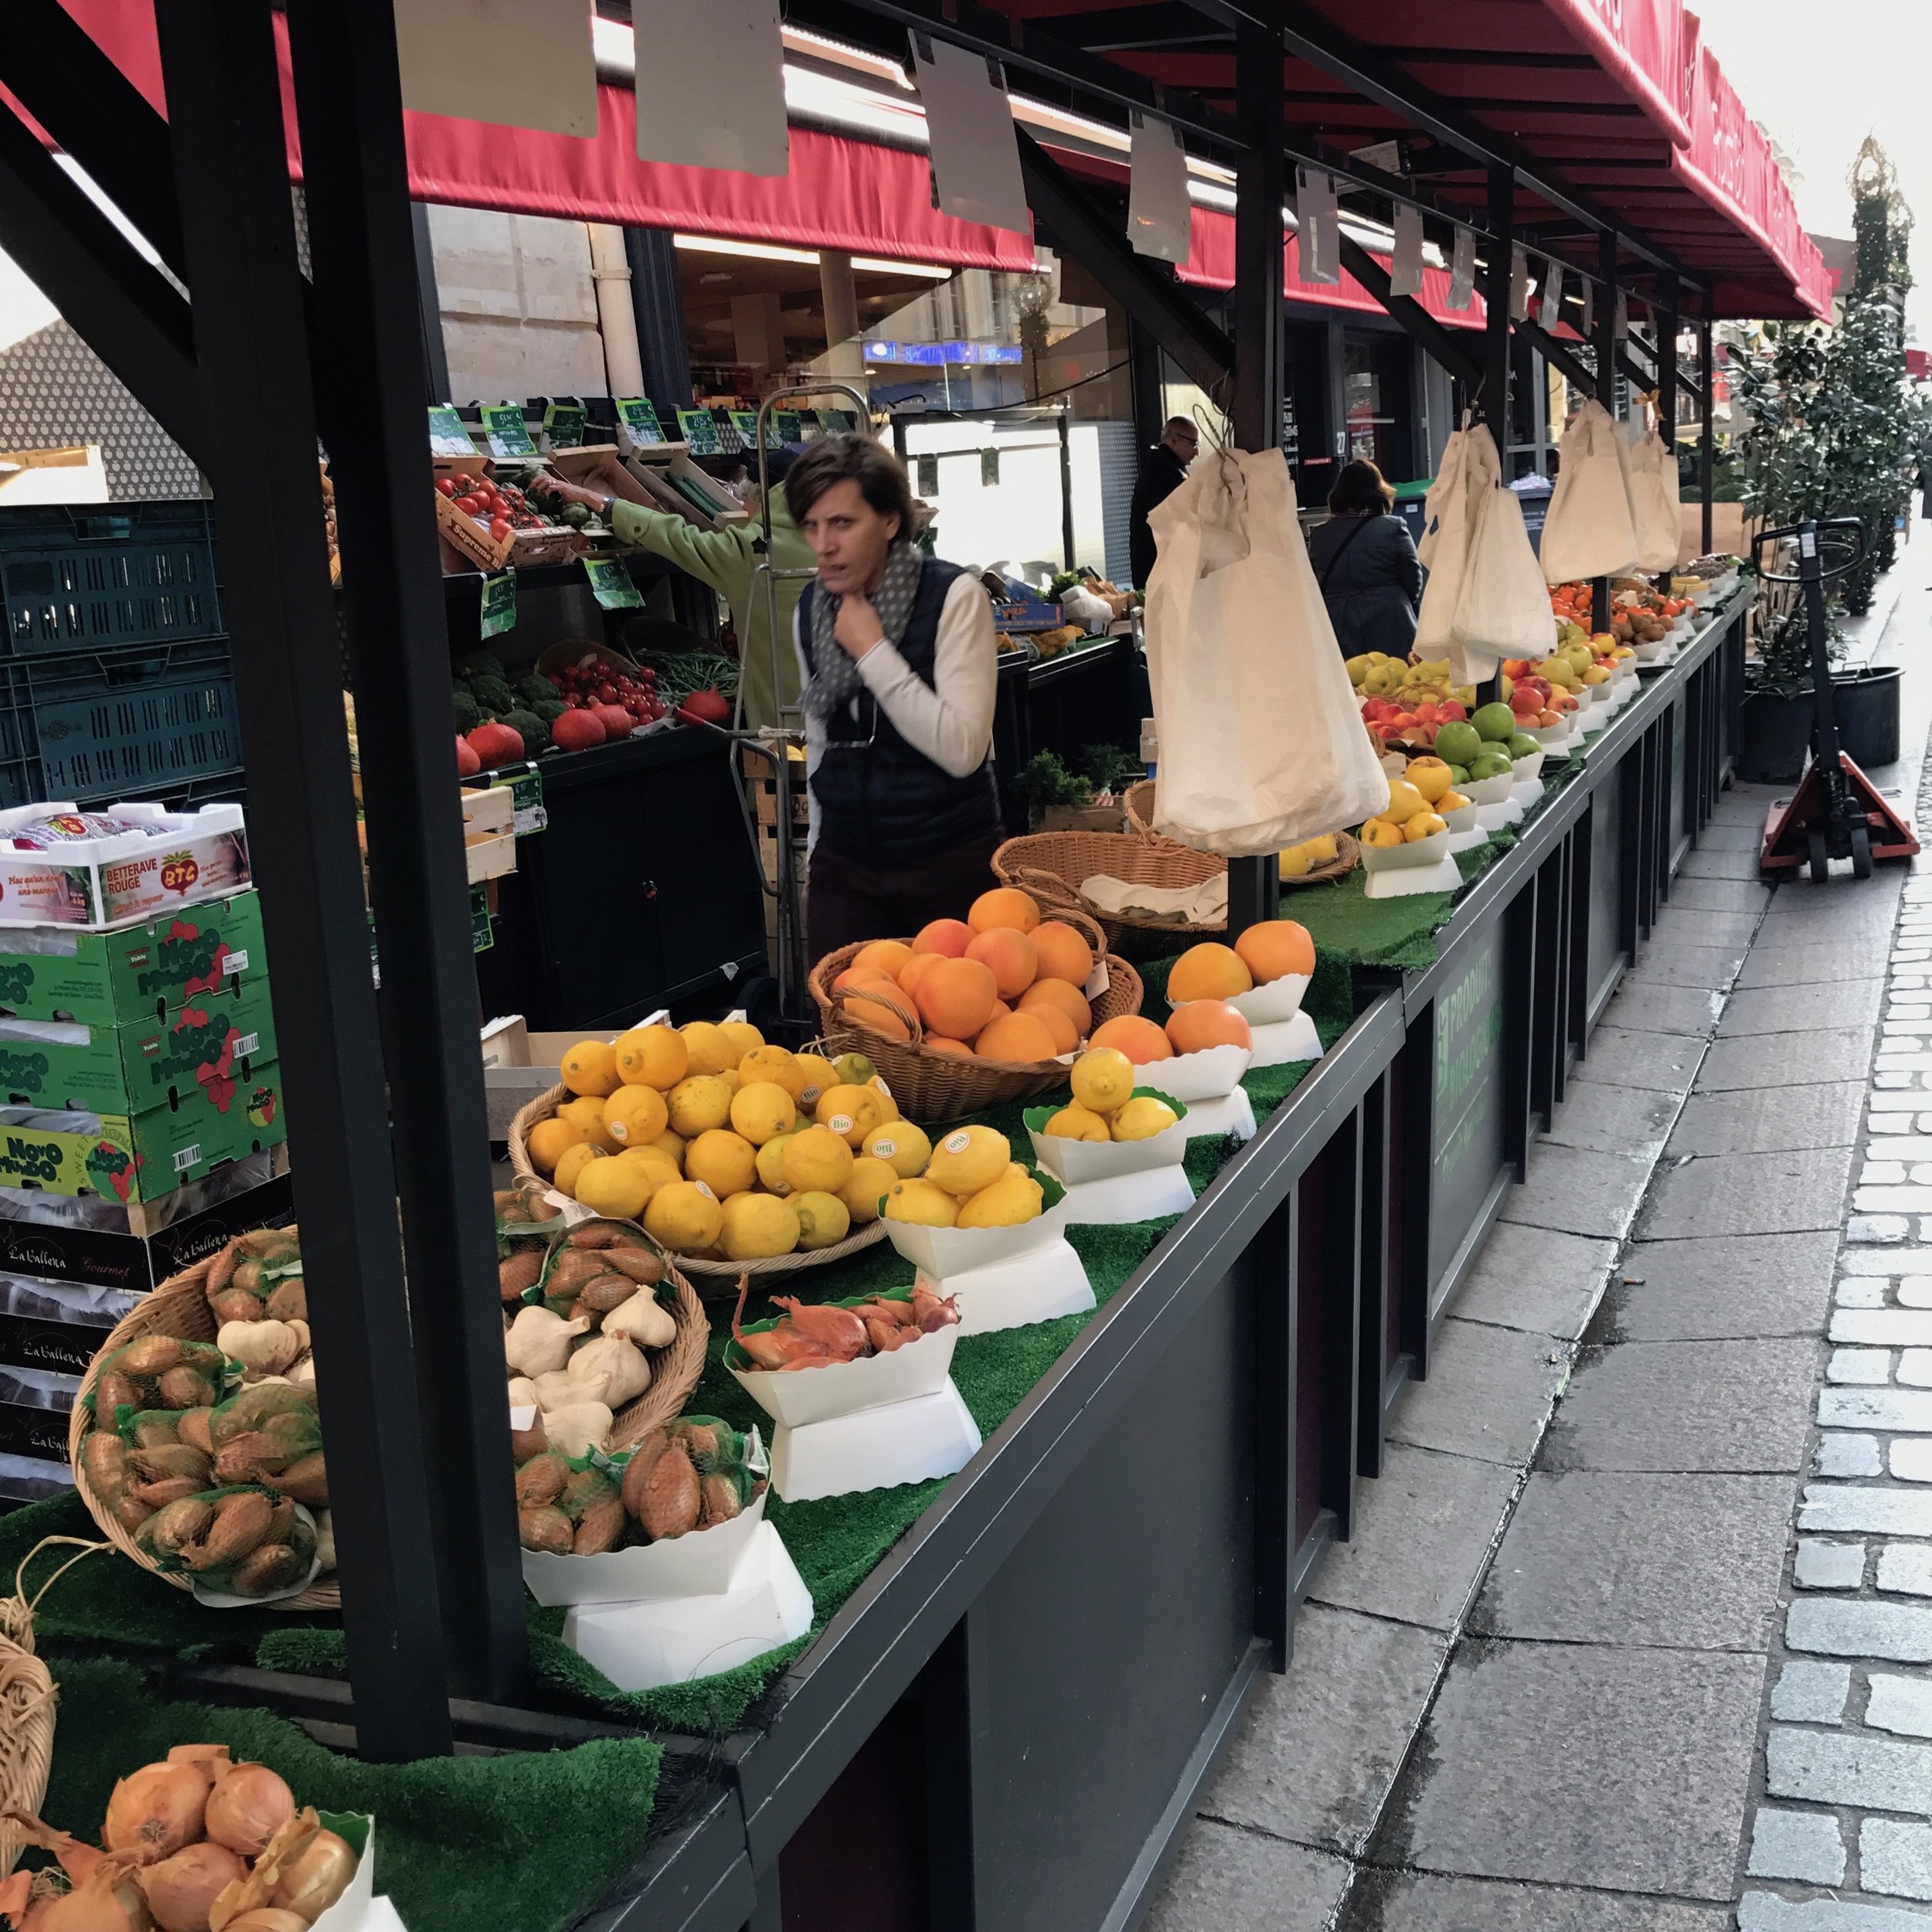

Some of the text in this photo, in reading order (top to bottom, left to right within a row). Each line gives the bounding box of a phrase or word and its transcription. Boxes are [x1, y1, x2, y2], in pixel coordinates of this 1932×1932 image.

[1336, 431, 1346, 454] 27
[453, 524, 492, 563] Supreme
[106, 858, 158, 883] BETTERAVE
[165, 865, 196, 887] BTG
[9, 874, 23, 886] Plus
[108, 876, 141, 896] ROUGE
[32, 888, 59, 898] marque
[803, 1087, 819, 1100] Bio
[833, 1119, 849, 1129] Bio
[876, 1144, 893, 1154] Bio
[949, 1134, 968, 1149] Bio
[83, 1257, 131, 1277] Gourmet
